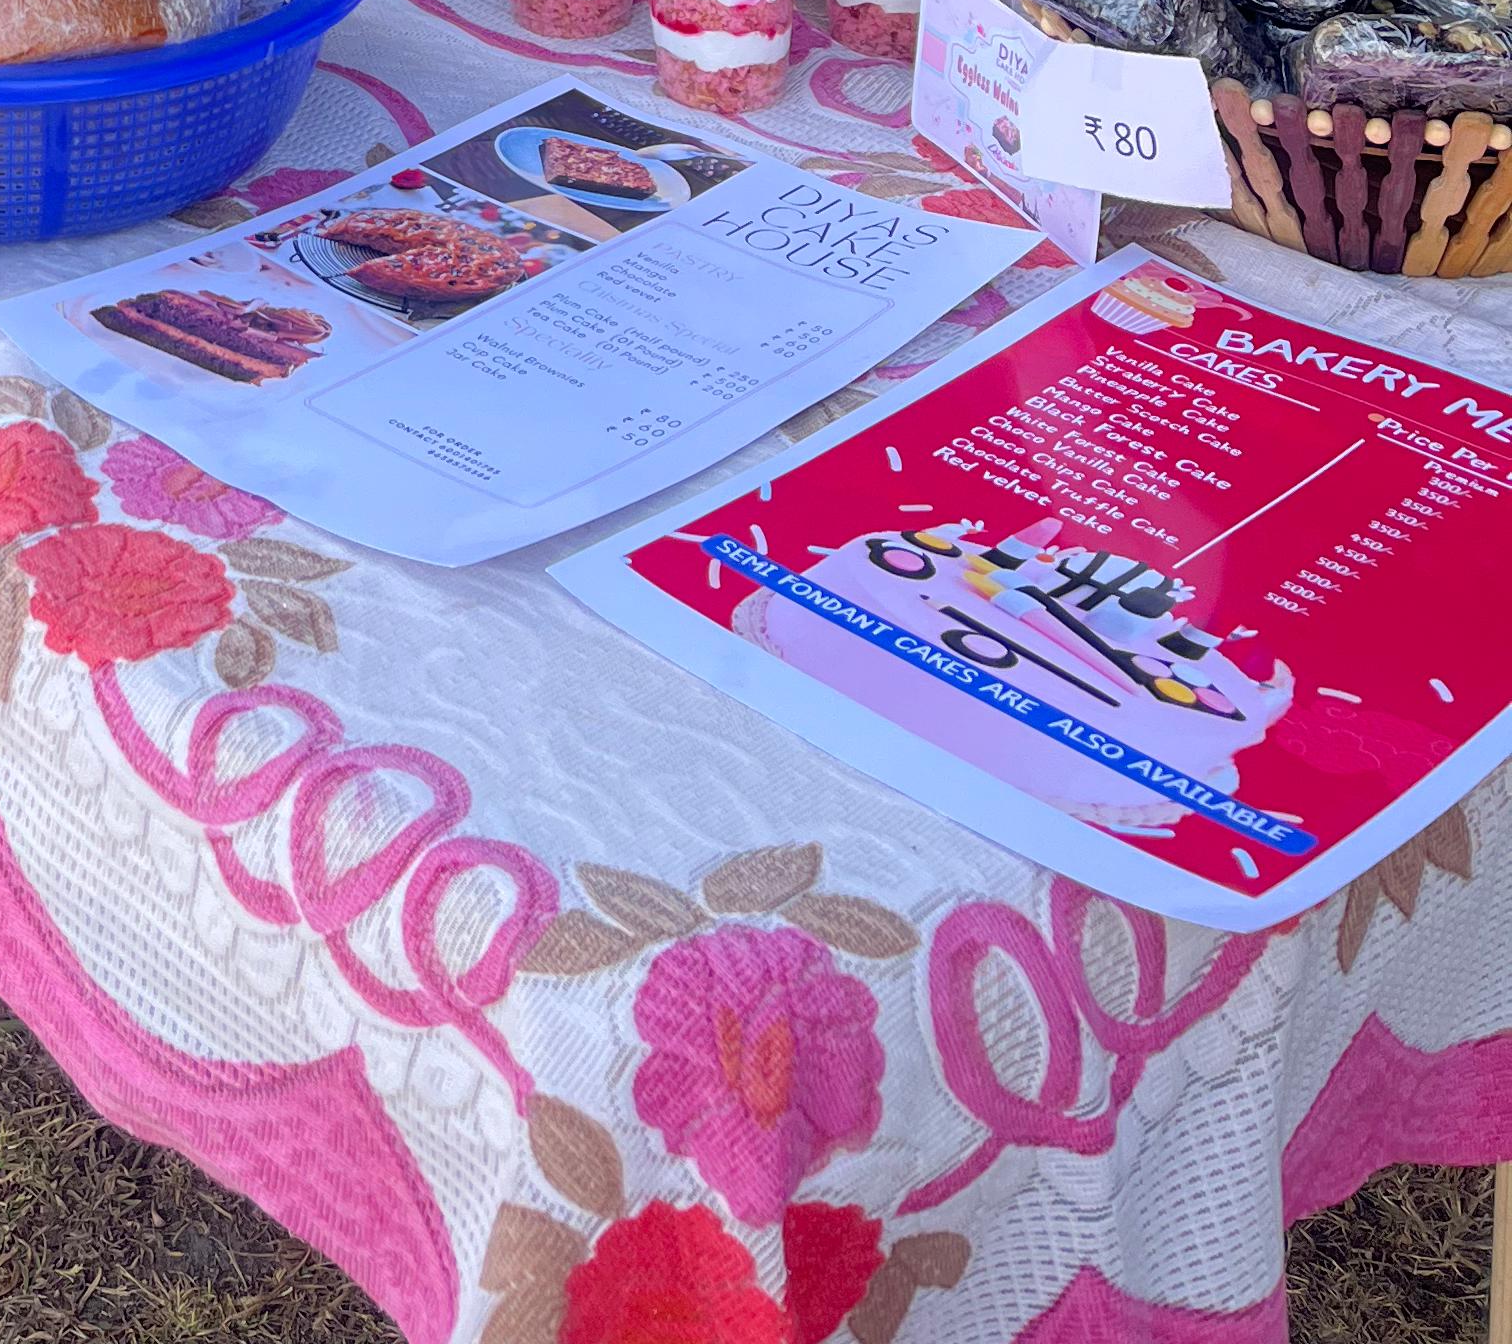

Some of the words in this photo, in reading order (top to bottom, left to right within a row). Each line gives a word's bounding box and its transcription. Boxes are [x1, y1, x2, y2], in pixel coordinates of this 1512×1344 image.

[957, 54, 990, 94] Eggless
[999, 42, 1028, 75] DIYA
[1084, 114, 1158, 161] ₹80
[778, 184, 950, 246] DIYAS
[701, 210, 911, 290] HOUSE
[761, 206, 916, 265] CAKE
[596, 271, 626, 286] Red
[623, 258, 668, 281] Mango
[652, 242, 745, 283] PASTRY
[610, 264, 678, 298] Chocolate
[528, 307, 550, 322] Tea
[552, 320, 587, 338] Cake
[539, 300, 568, 316] Plum
[572, 315, 605, 333] Cake
[552, 292, 582, 310] Plum
[585, 308, 618, 326] Cake
[624, 326, 663, 344] (Half
[657, 344, 711, 367] pound)
[446, 348, 470, 361] Jar
[471, 360, 507, 380] Cake
[462, 341, 488, 357] Cup
[492, 356, 528, 375] Cake
[477, 333, 524, 358] Walnut
[524, 356, 585, 388] Brownies
[1106, 346, 1164, 377] Vanilla
[1171, 374, 1216, 396] Cake
[1170, 343, 1284, 390] CAKES
[1215, 329, 1441, 398] BAKERY
[1076, 365, 1167, 407] Pineapple
[1182, 409, 1230, 432] Cake
[1091, 355, 1186, 399] Straberry
[1192, 397, 1240, 421] Cake
[656, 415, 682, 428] 80
[1042, 386, 1102, 415] Mango
[1108, 413, 1154, 436] Cake
[1058, 376, 1121, 405] Butter
[1126, 404, 1190, 435] Scotch
[1197, 433, 1242, 456] Cake
[388, 419, 438, 445] CONTACT
[422, 425, 445, 438] FOR
[446, 437, 482, 457] ORDER
[621, 432, 648, 446] 50
[638, 424, 665, 437] 60
[1006, 406, 1058, 433] White
[1063, 430, 1127, 462] Forest
[1133, 461, 1181, 488] Cake
[1025, 396, 1086, 426] Black
[1093, 423, 1168, 460] Forest
[1176, 459, 1232, 490] Cake
[1377, 418, 1445, 452] Price
[1451, 447, 1498, 470] Per
[932, 446, 979, 471] Red
[983, 470, 1052, 506] velvet
[970, 426, 1026, 455] Choco
[1032, 452, 1085, 481] Chips
[1091, 479, 1139, 506] Cake
[988, 416, 1045, 444] Choco
[1052, 441, 1115, 476] Vanilla
[1122, 474, 1171, 501] Cake
[952, 437, 1041, 481] Chocolate
[1051, 479, 1125, 520] Truffle
[1130, 518, 1179, 544] Cake
[1423, 461, 1499, 498] Premium
[1429, 477, 1473, 499] 300/-
[1401, 498, 1444, 520] 350/-
[1417, 487, 1461, 509] 350/-
[1368, 520, 1412, 543] 350/-
[1385, 508, 1429, 530] 350/-
[1334, 545, 1378, 567] 450/-
[1350, 534, 1395, 555] 450/-
[1297, 569, 1343, 592] 500/-
[1315, 556, 1361, 580] 500/-
[1264, 592, 1310, 616] 500/-
[1280, 581, 1327, 604] 500/-
[716, 539, 779, 577] SEMI
[778, 574, 894, 636] FONDANT
[894, 636, 979, 684] CAKES
[979, 677, 1040, 715] ARE
[1047, 718, 1126, 760] ALSO
[1127, 760, 1294, 842] AVAILABLE
